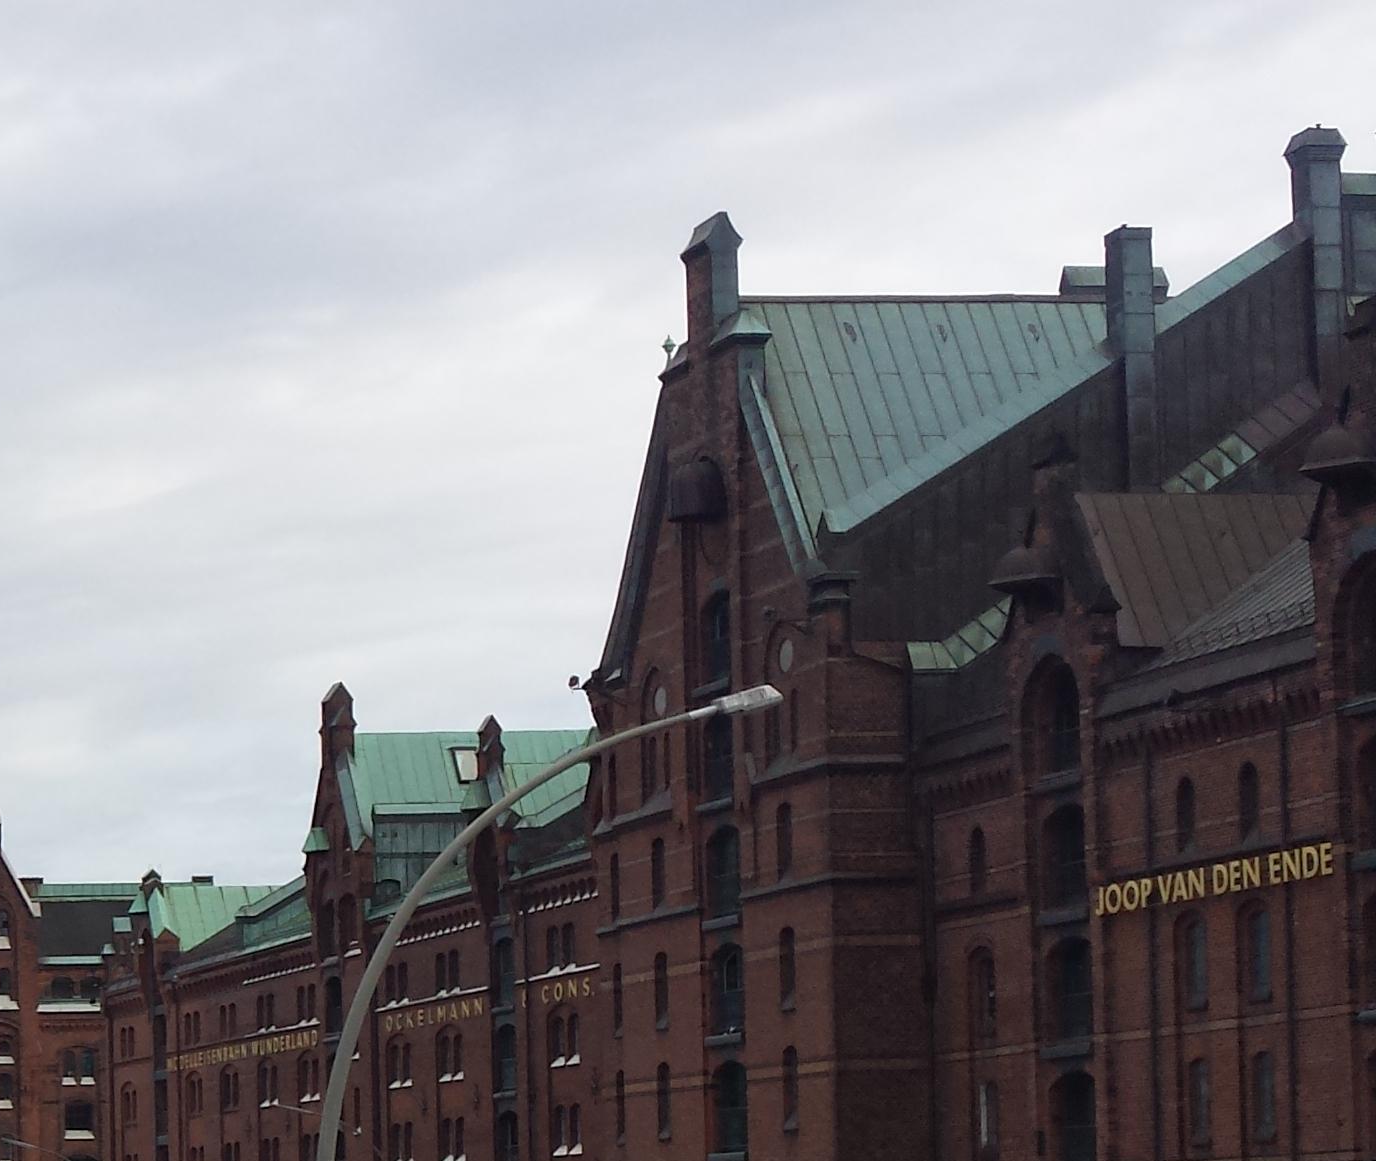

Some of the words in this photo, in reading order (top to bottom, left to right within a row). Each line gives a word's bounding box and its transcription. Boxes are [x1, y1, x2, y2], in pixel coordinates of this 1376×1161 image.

[1095, 879, 1153, 916] JOOP
[1158, 867, 1205, 905] VAN
[1212, 856, 1260, 895] DEN
[1268, 842, 1334, 885] ENDE
[385, 998, 484, 1032] OCKELMANN
[251, 1029, 319, 1056] WUNDERLAND
